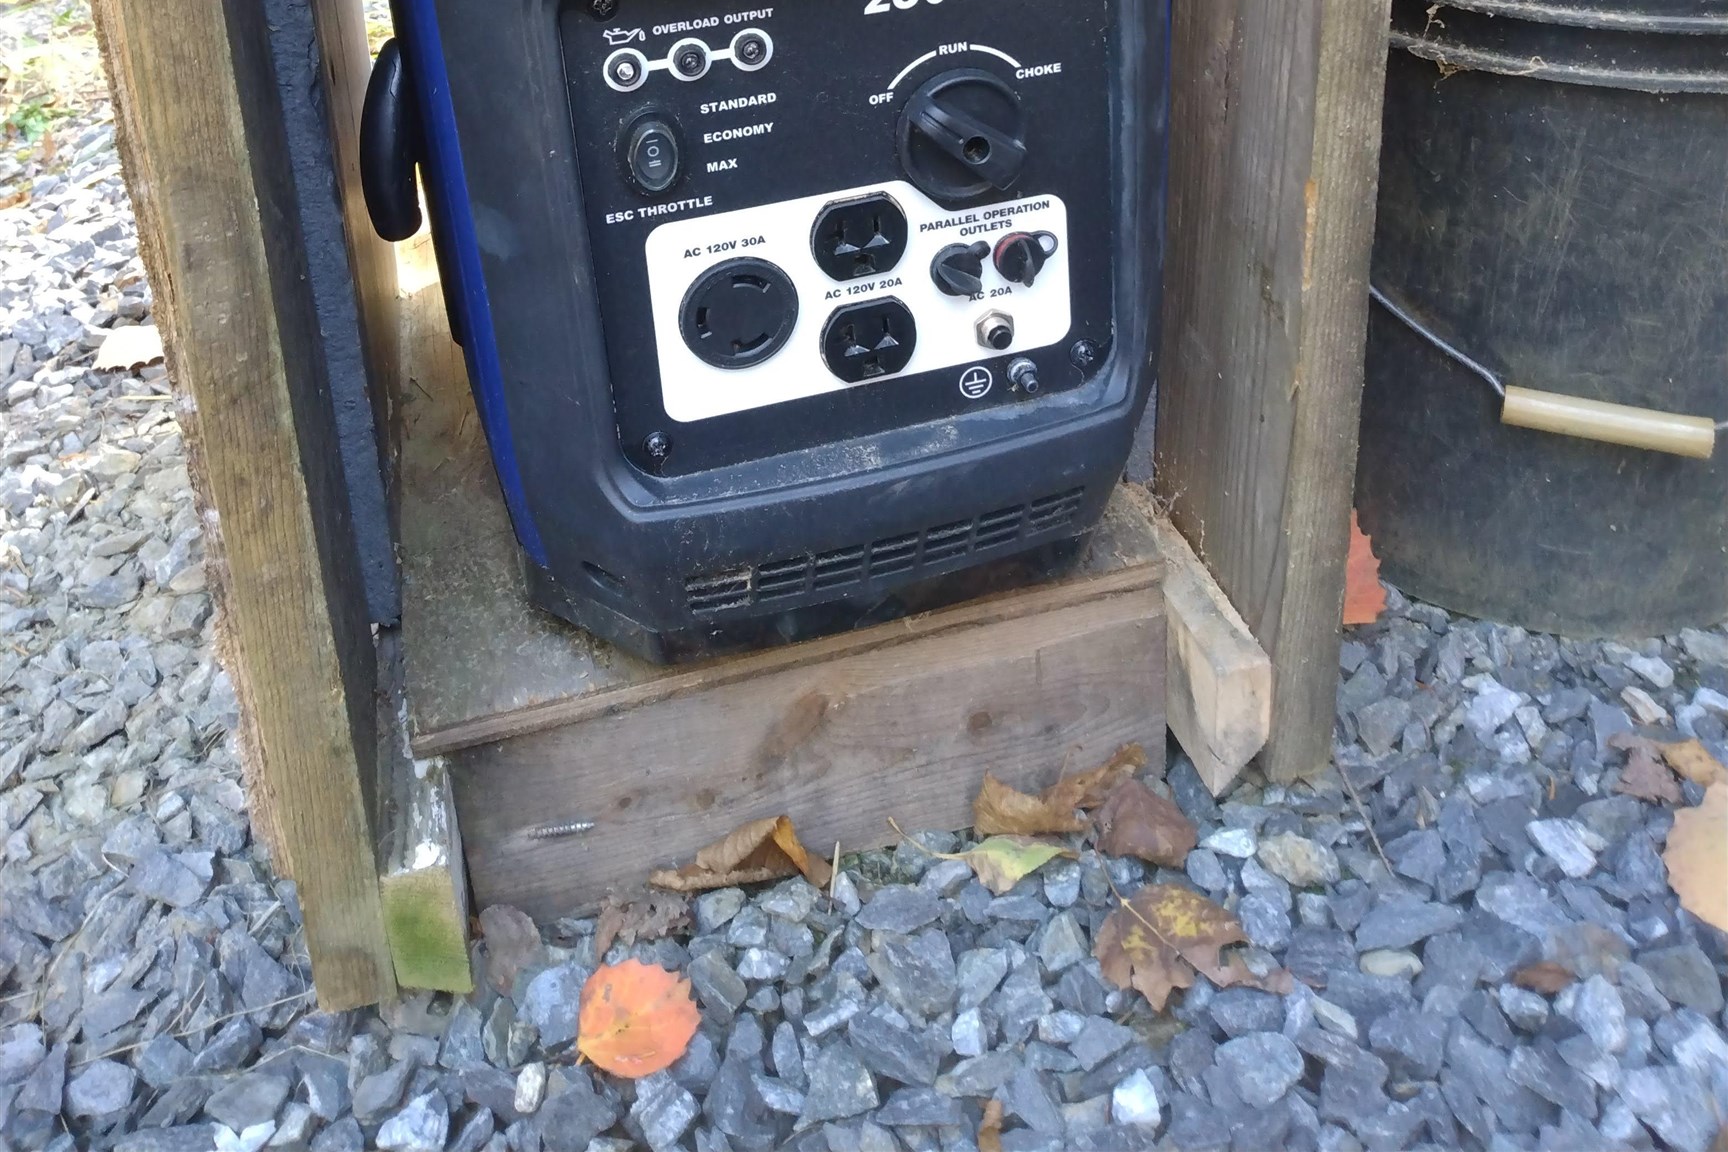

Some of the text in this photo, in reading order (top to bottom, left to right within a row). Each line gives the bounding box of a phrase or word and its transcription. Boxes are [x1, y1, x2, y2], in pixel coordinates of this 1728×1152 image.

[652, 7, 774, 36] OVERLOAD OUTPUT
[938, 41, 968, 56] RUN
[1015, 62, 1062, 80] CHOKE
[700, 92, 777, 114] STANDARD
[868, 91, 894, 106] OFF
[703, 122, 774, 144] ECONOMY
[706, 157, 738, 173] MAX
[605, 195, 713, 225] ESC THROTTLE
[919, 200, 1050, 233] PARALLEL OPERATION
[959, 219, 1013, 237] OUTLETS
[684, 235, 766, 259] AC 120V 30A
[824, 277, 903, 300] AC 120V 20A
[968, 285, 1013, 302] AC 20A
